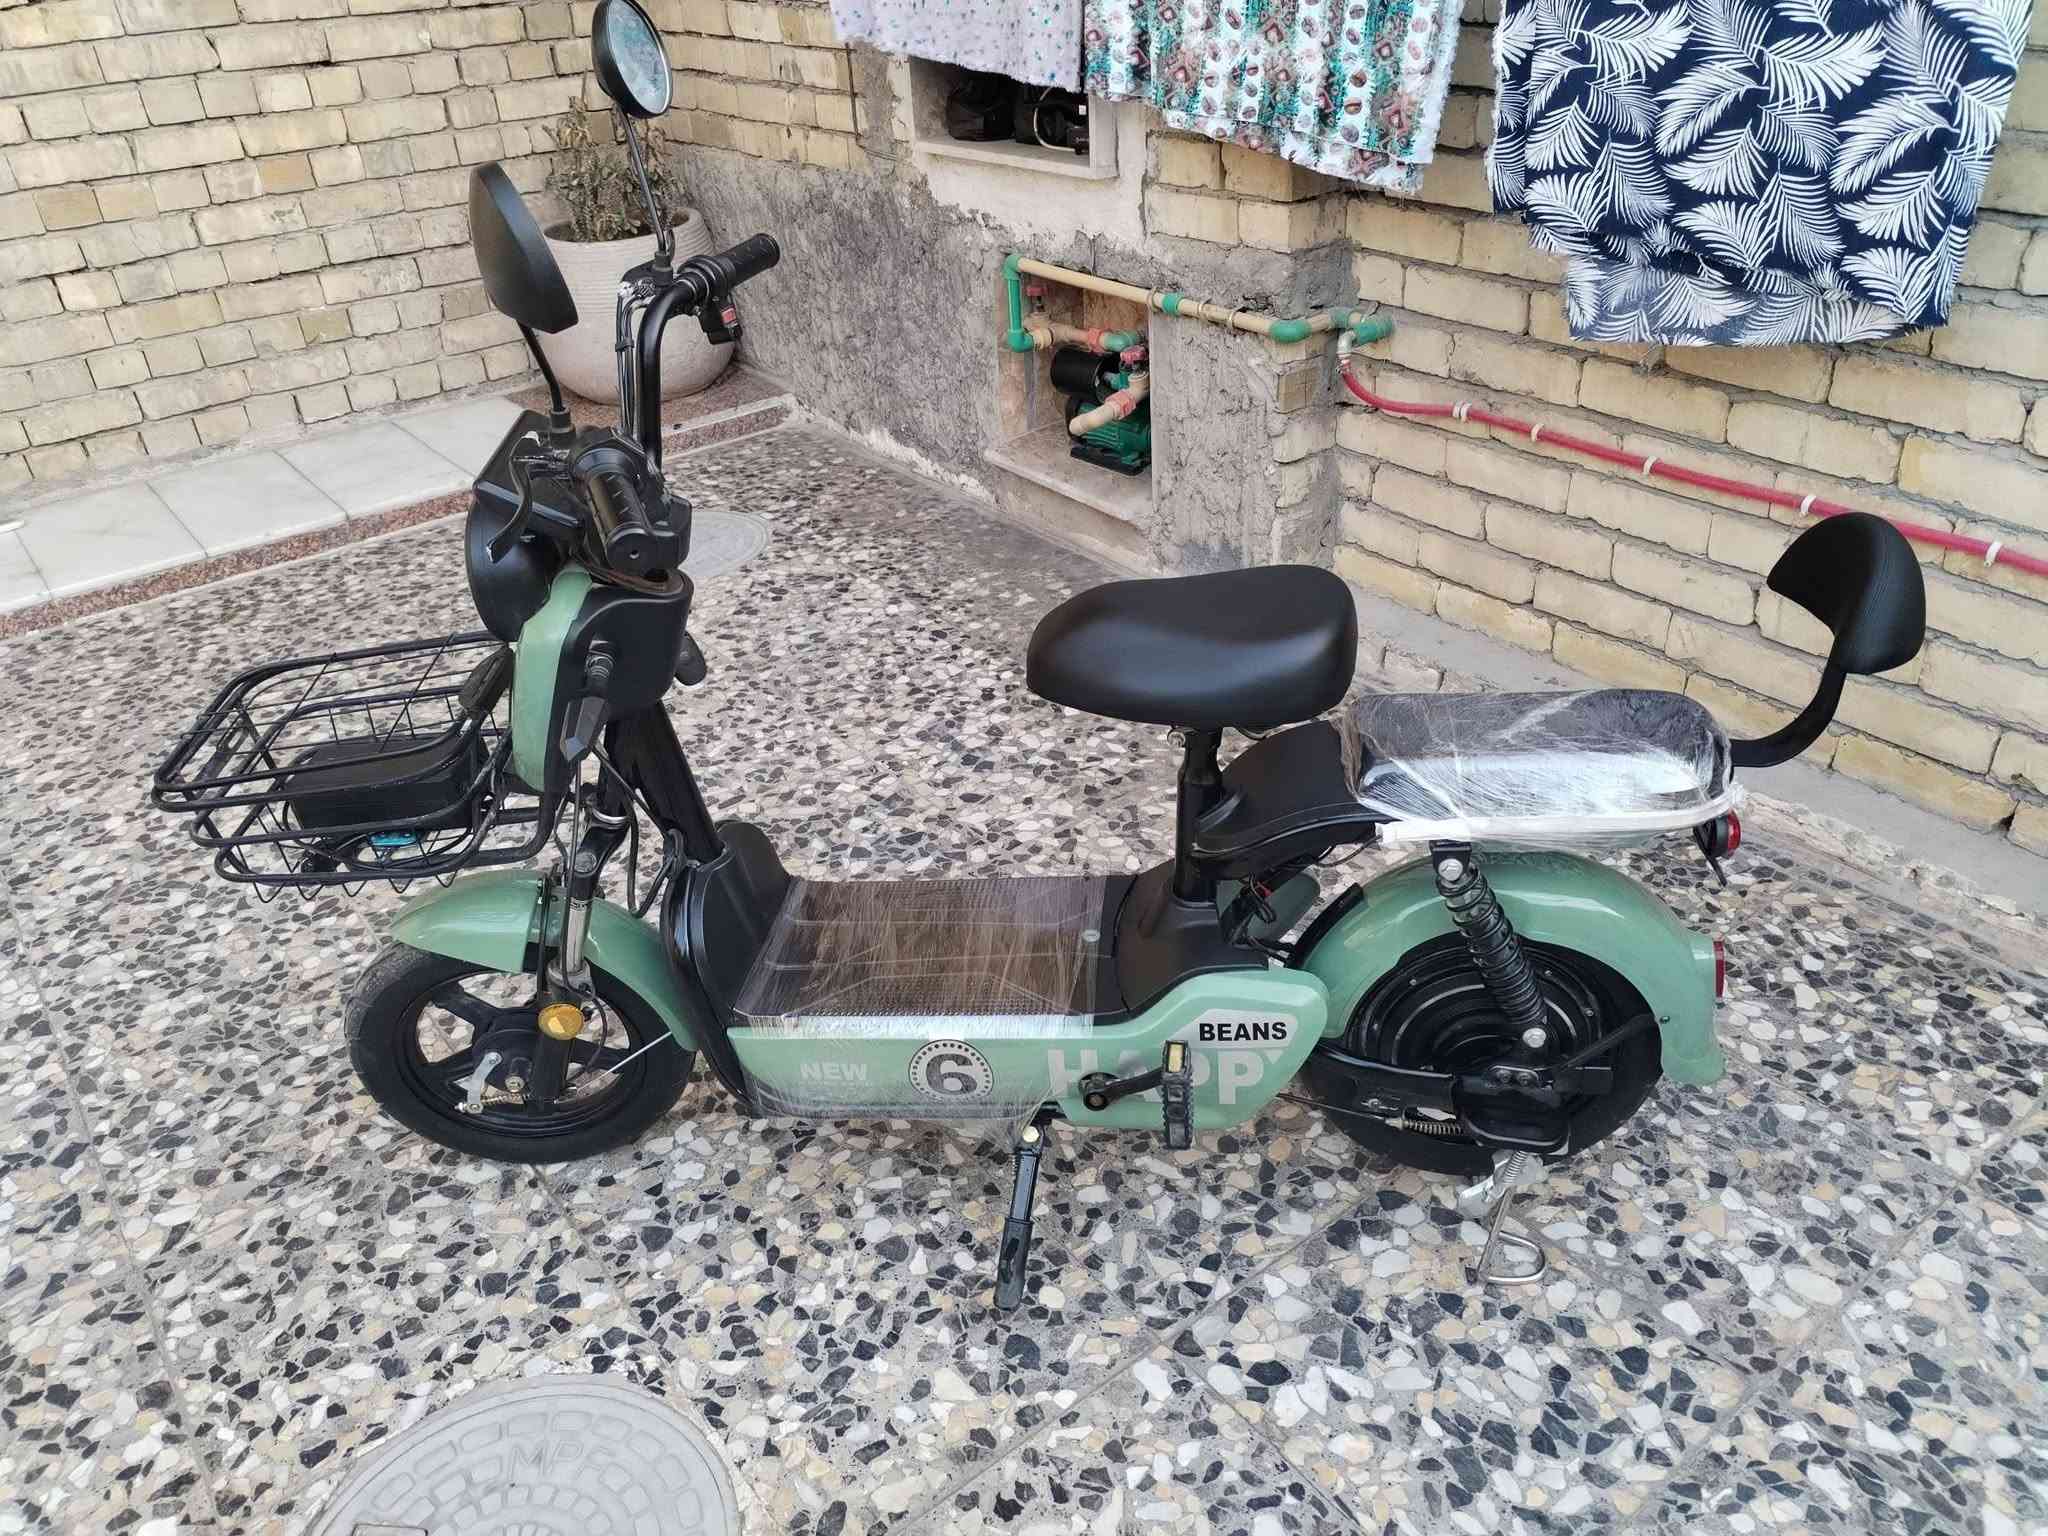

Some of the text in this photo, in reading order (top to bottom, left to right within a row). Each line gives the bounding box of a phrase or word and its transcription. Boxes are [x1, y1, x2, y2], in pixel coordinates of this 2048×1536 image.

[1199, 1021, 1288, 1042] BEANS
[800, 1062, 868, 1081] NEW
[925, 1052, 978, 1096] 6
